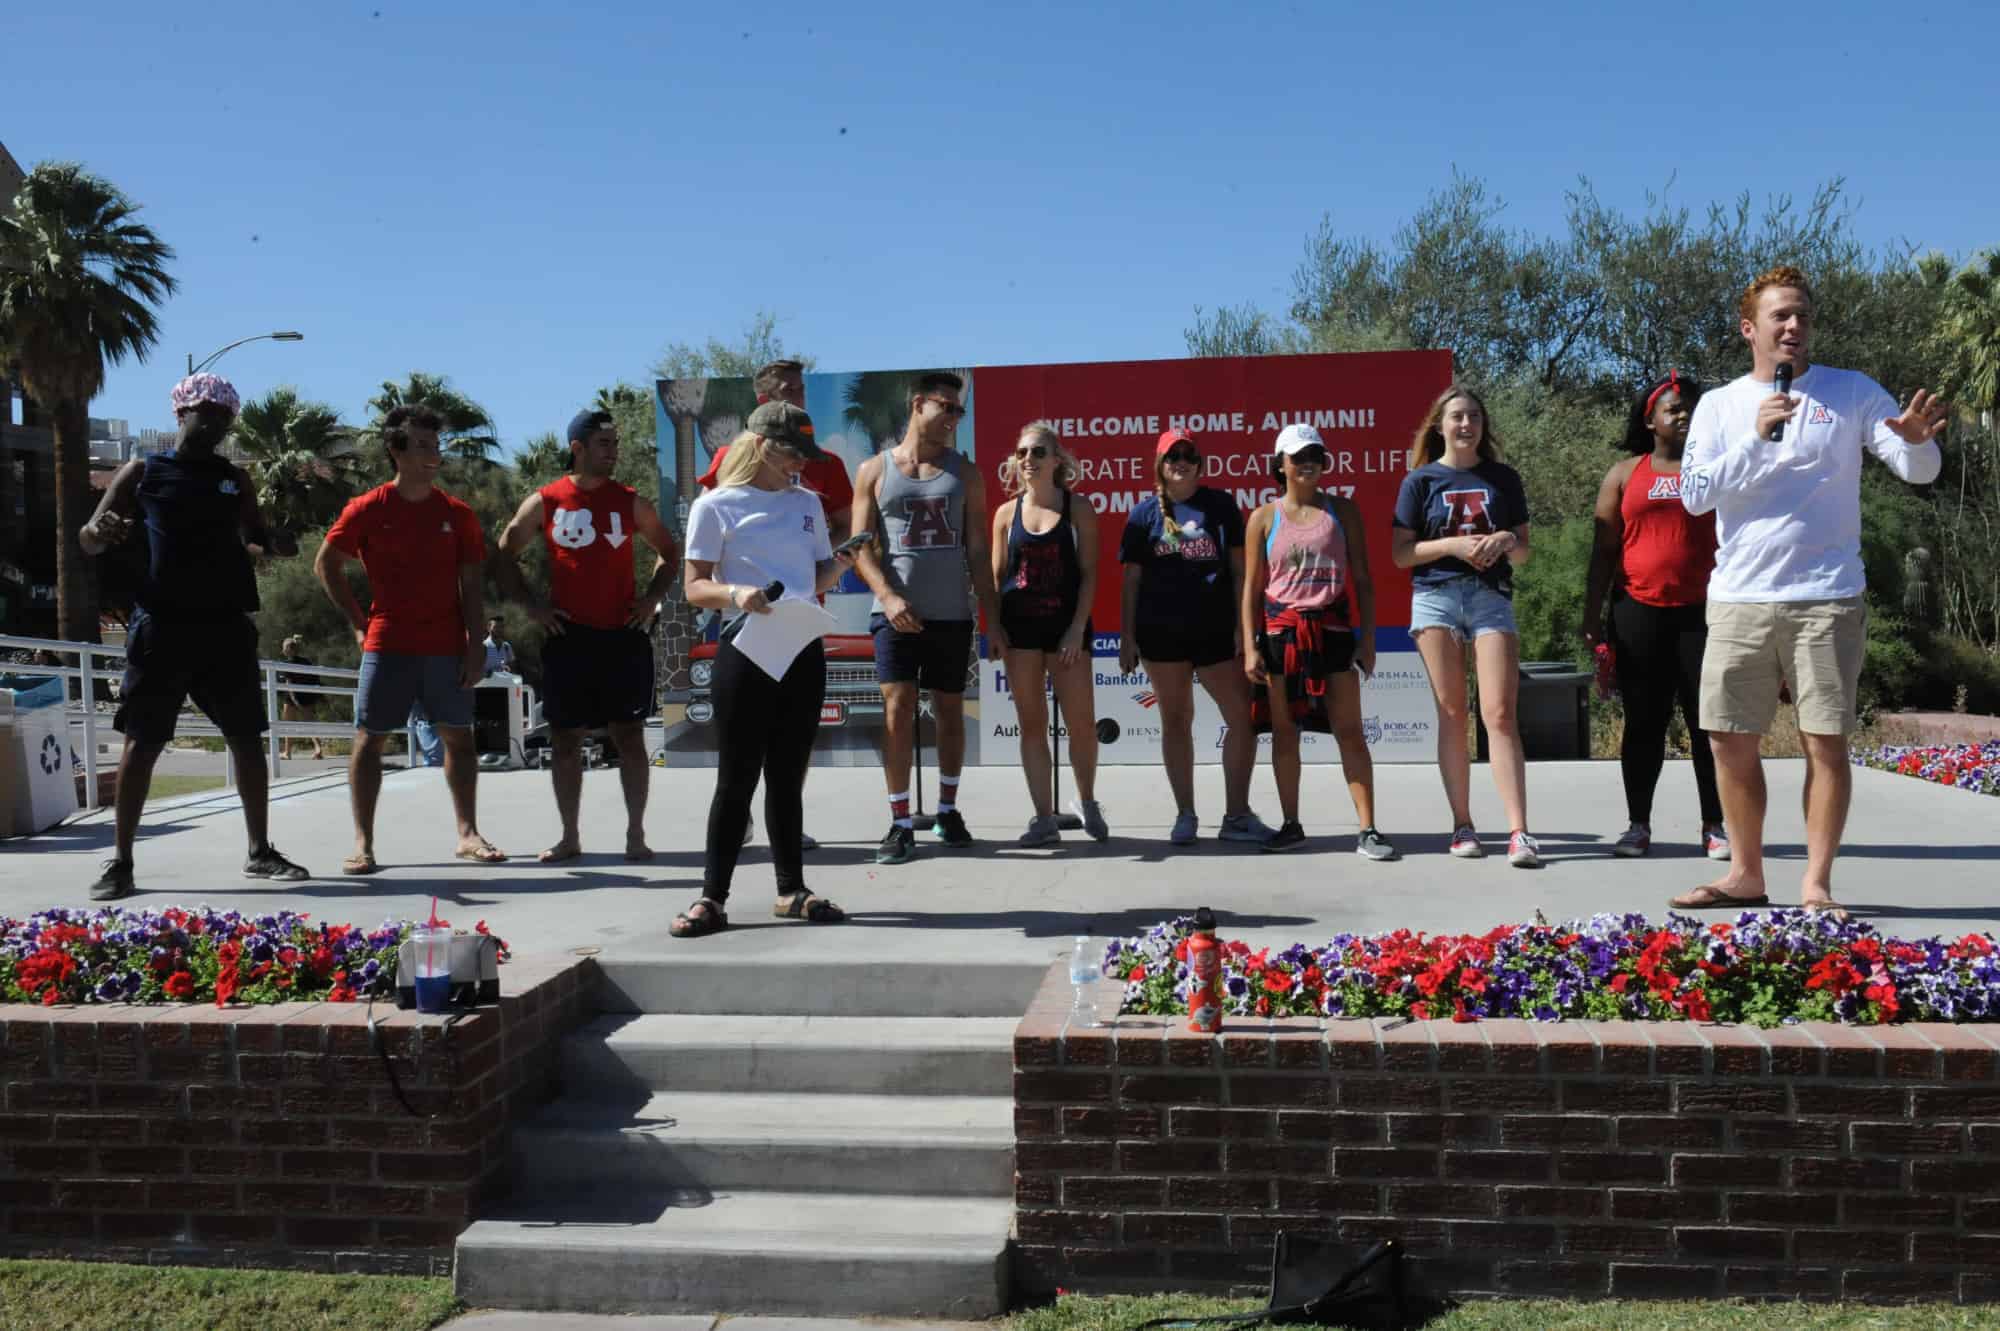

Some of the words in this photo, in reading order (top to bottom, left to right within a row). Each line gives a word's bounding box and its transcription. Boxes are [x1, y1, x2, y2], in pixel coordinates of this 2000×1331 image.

[1168, 412, 1254, 435] HOME,
[1809, 405, 1833, 425] A
[1648, 476, 1682, 499] A
[899, 496, 960, 550] A
[1440, 489, 1496, 537] A
[1130, 672, 1145, 686] of
